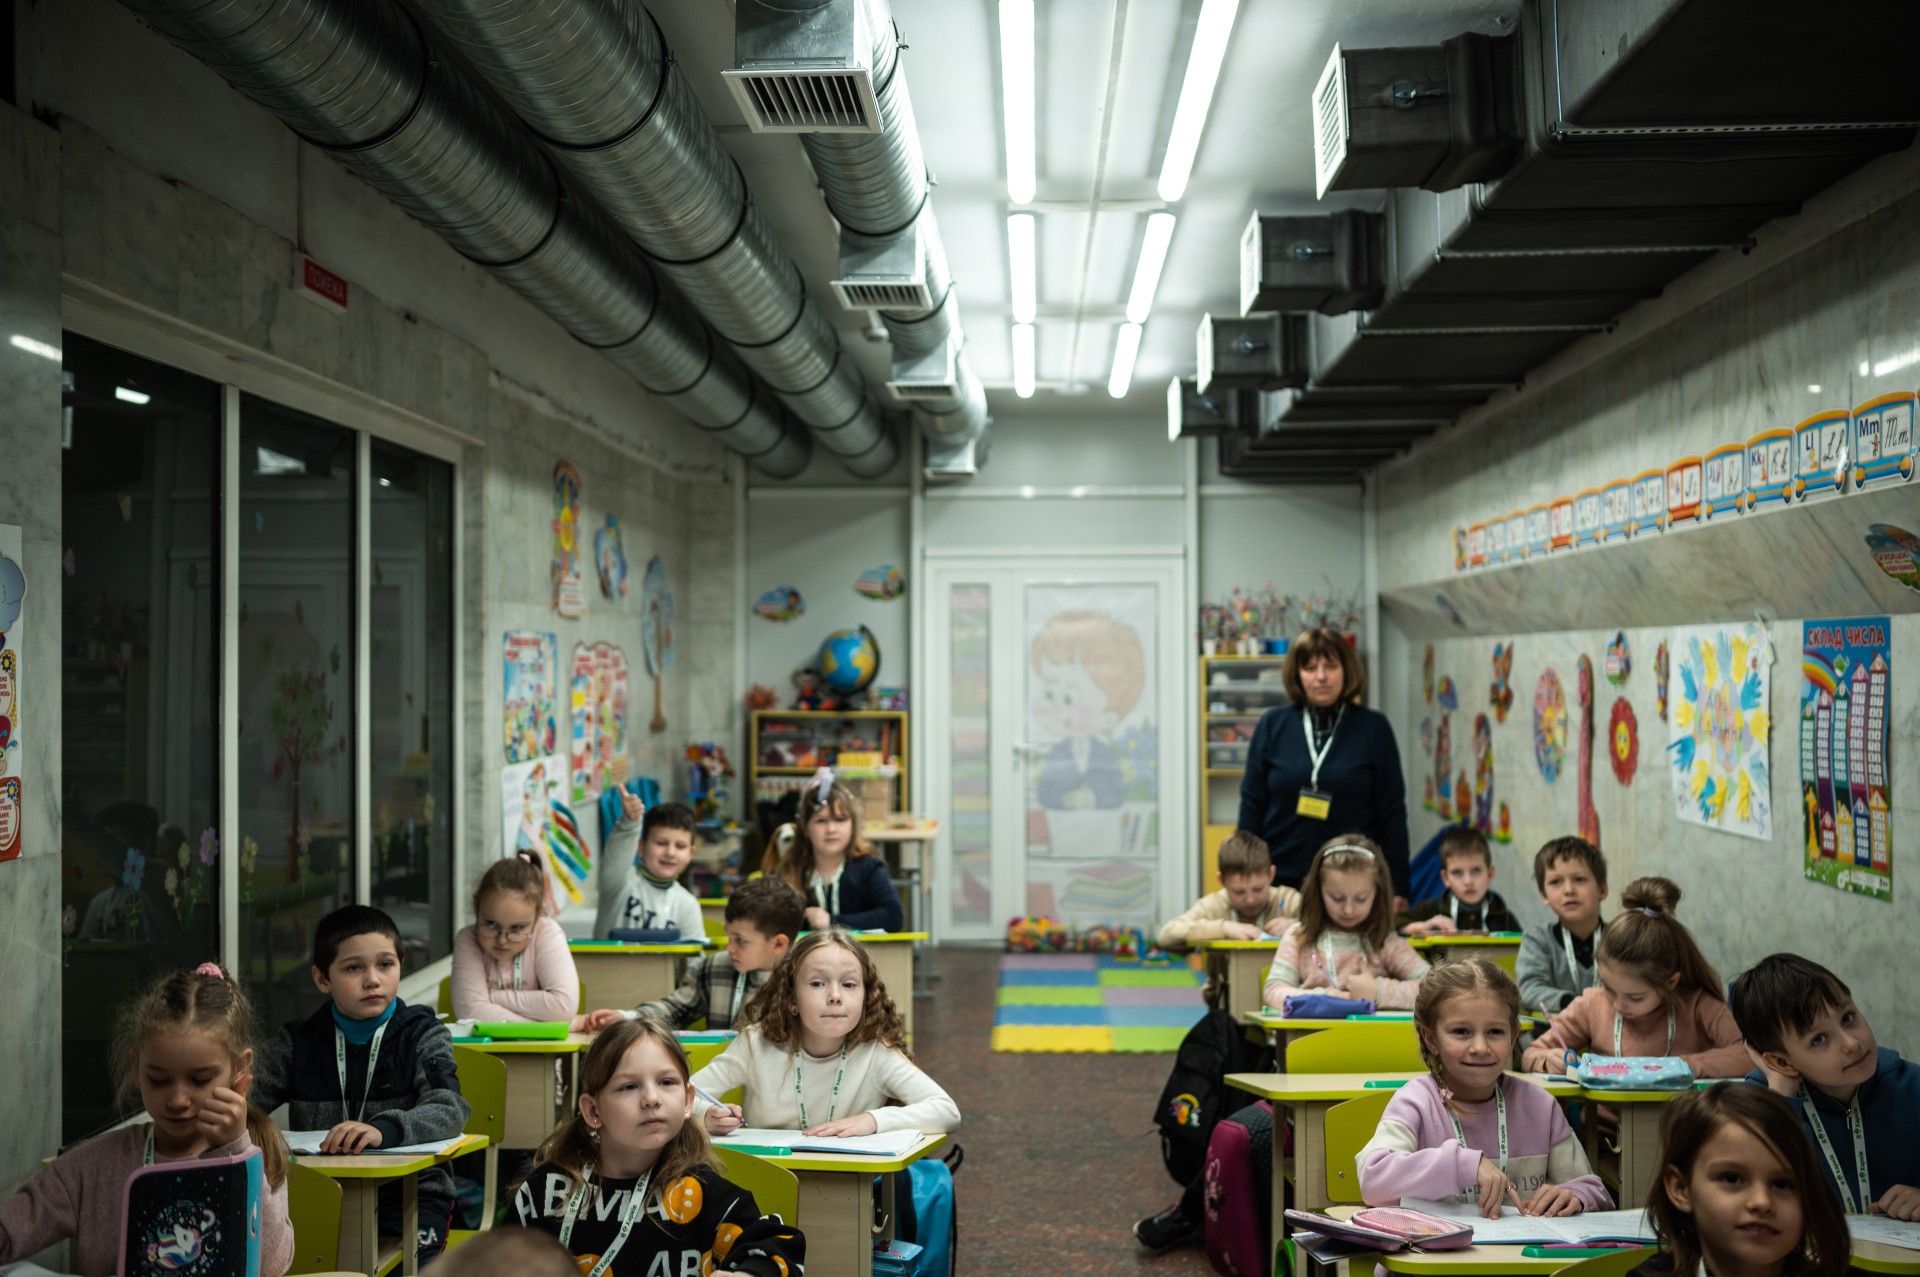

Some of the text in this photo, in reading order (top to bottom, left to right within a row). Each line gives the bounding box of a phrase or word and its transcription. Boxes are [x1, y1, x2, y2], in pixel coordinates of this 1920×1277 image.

[1859, 418, 1879, 437] Mm
[1751, 450, 1761, 466] Kk
[1807, 625, 1885, 650] СКЛАД ЧИСЛА
[626, 1204, 638, 1226] Харків
[599, 1249, 615, 1268] Харків
